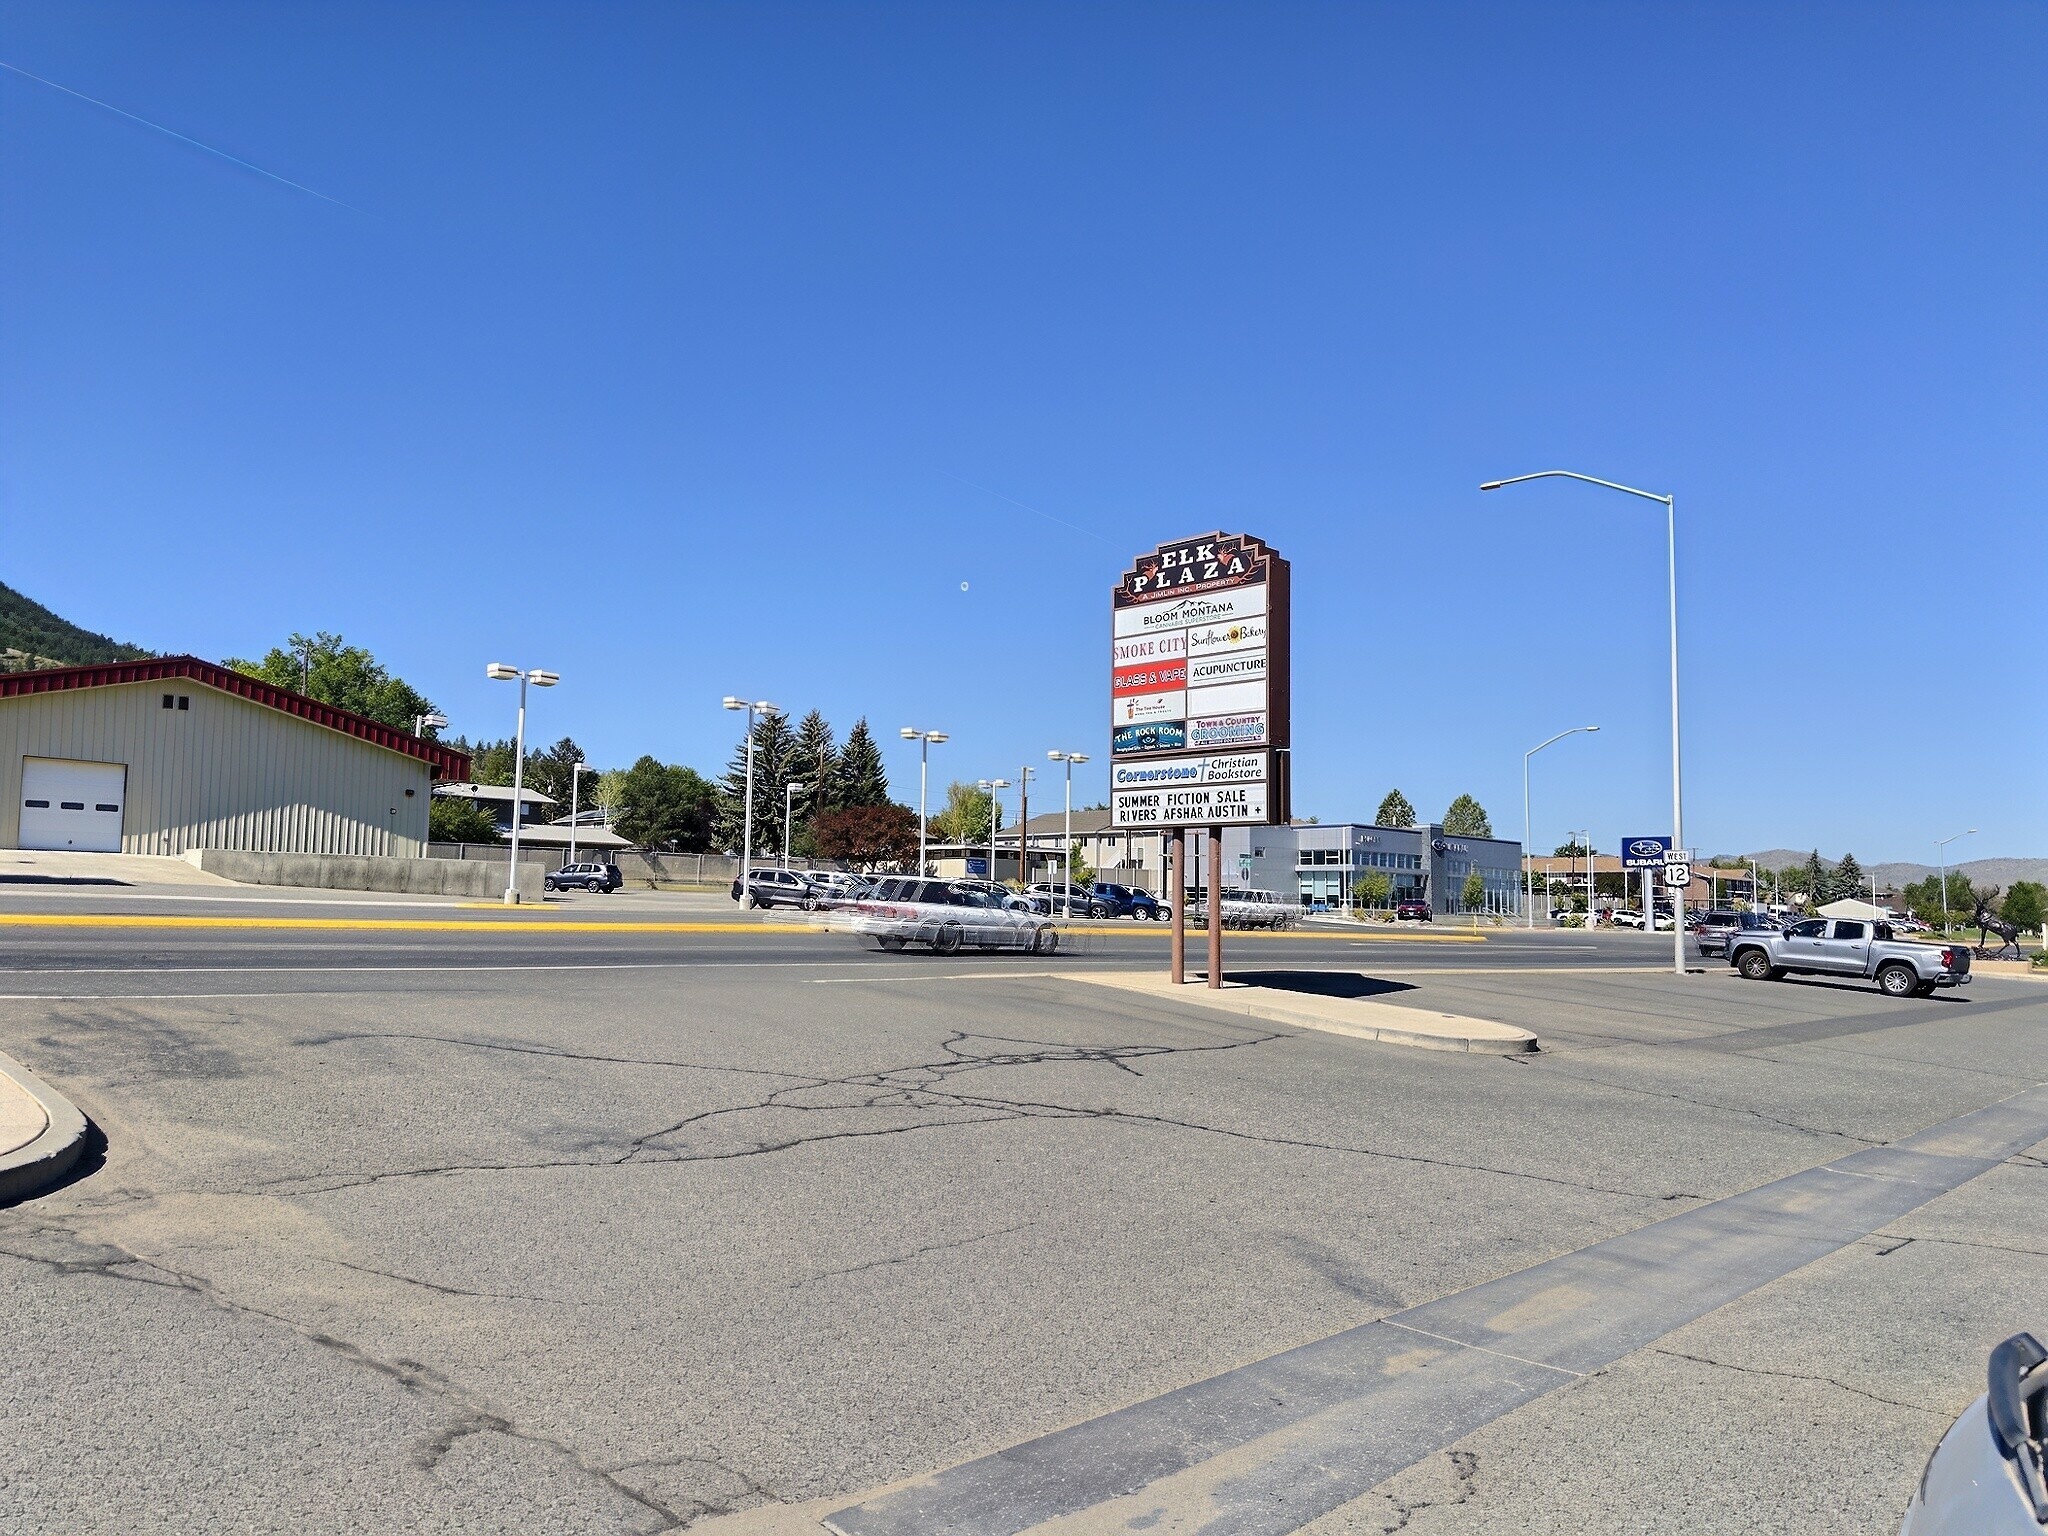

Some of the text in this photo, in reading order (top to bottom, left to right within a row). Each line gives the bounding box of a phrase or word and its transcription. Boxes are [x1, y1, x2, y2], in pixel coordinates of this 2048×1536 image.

[1162, 544, 1216, 569] ELK
[1134, 557, 1245, 593] PLAZA
[1151, 589, 1175, 599] JIMLIN
[1177, 586, 1192, 594] INC.
[1195, 577, 1235, 591] PROPERTY
[1144, 601, 1234, 626] BLOOM MONTANA
[1155, 613, 1222, 630] CANNABIS SUPERSTORE
[1191, 626, 1266, 648] Sunflower Bakery
[1113, 636, 1186, 661] SMOKE CITY
[1193, 659, 1266, 677] ACUPUNCTURE
[1114, 668, 1186, 688] GLASS & VAPE
[1196, 720, 1217, 729] TOWN
[1225, 715, 1261, 726] COUNTRY
[1116, 725, 1183, 743] THE ROCK ROOM
[1191, 723, 1265, 741] GROOMING
[1212, 758, 1258, 769] Christian
[1117, 766, 1197, 782] Cornerstone
[1208, 767, 1262, 781] Bookstore
[1118, 789, 1246, 808] SUMMER FICTION SALE
[1120, 808, 1157, 822] RIVERS
[1164, 806, 1204, 820] AFSHAR
[1207, 804, 1248, 818] AUSTIN
[1670, 868, 1685, 881] 12
